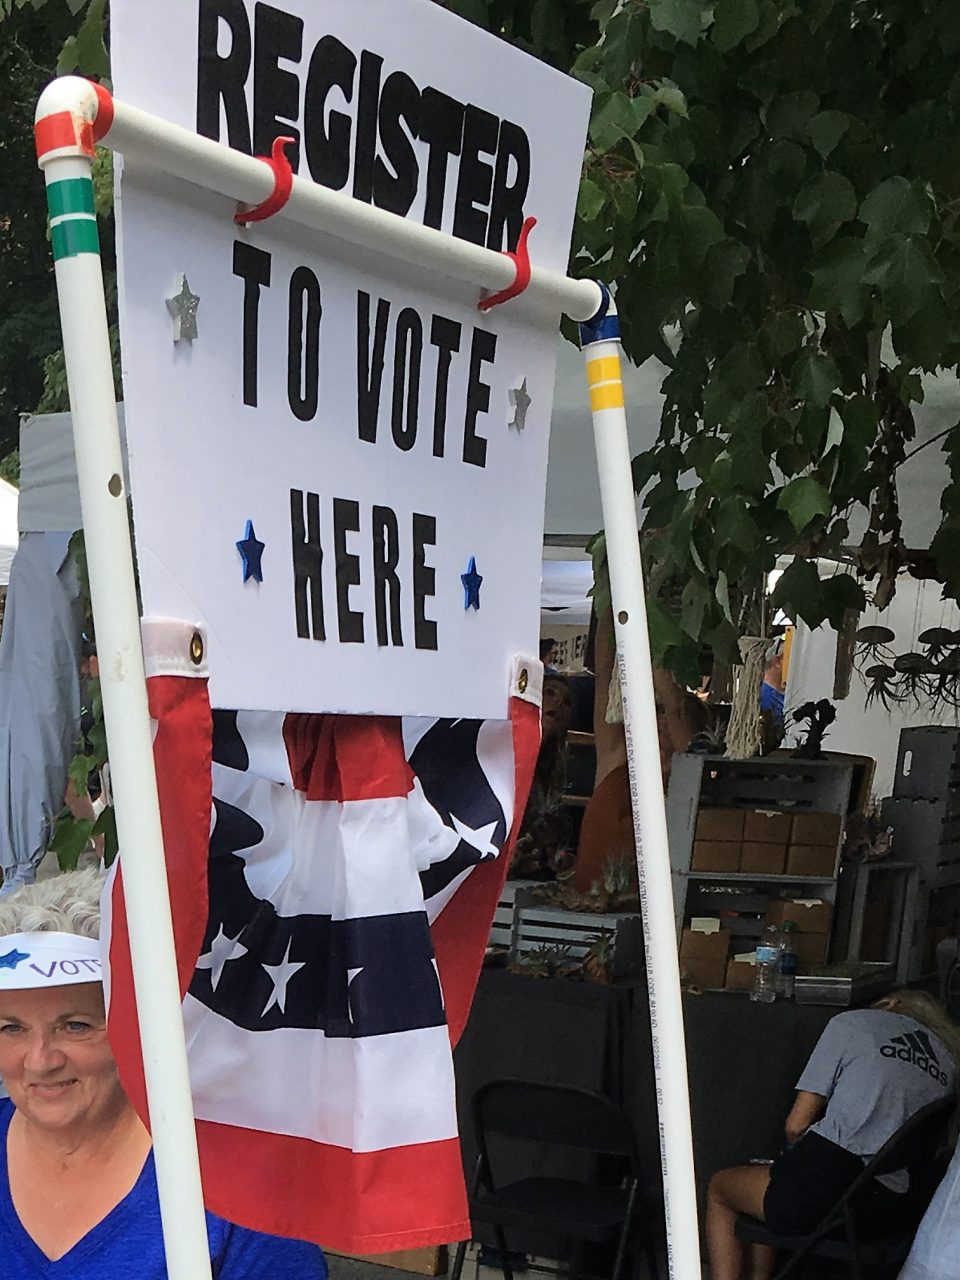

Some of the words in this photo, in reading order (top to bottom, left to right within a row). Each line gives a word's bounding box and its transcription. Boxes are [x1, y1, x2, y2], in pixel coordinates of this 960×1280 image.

[196, 0, 531, 253] REGISTER
[233, 240, 322, 422] TO
[357, 289, 497, 468] VOTE
[290, 488, 438, 651] HERE
[880, 1045, 948, 1087] adidas
